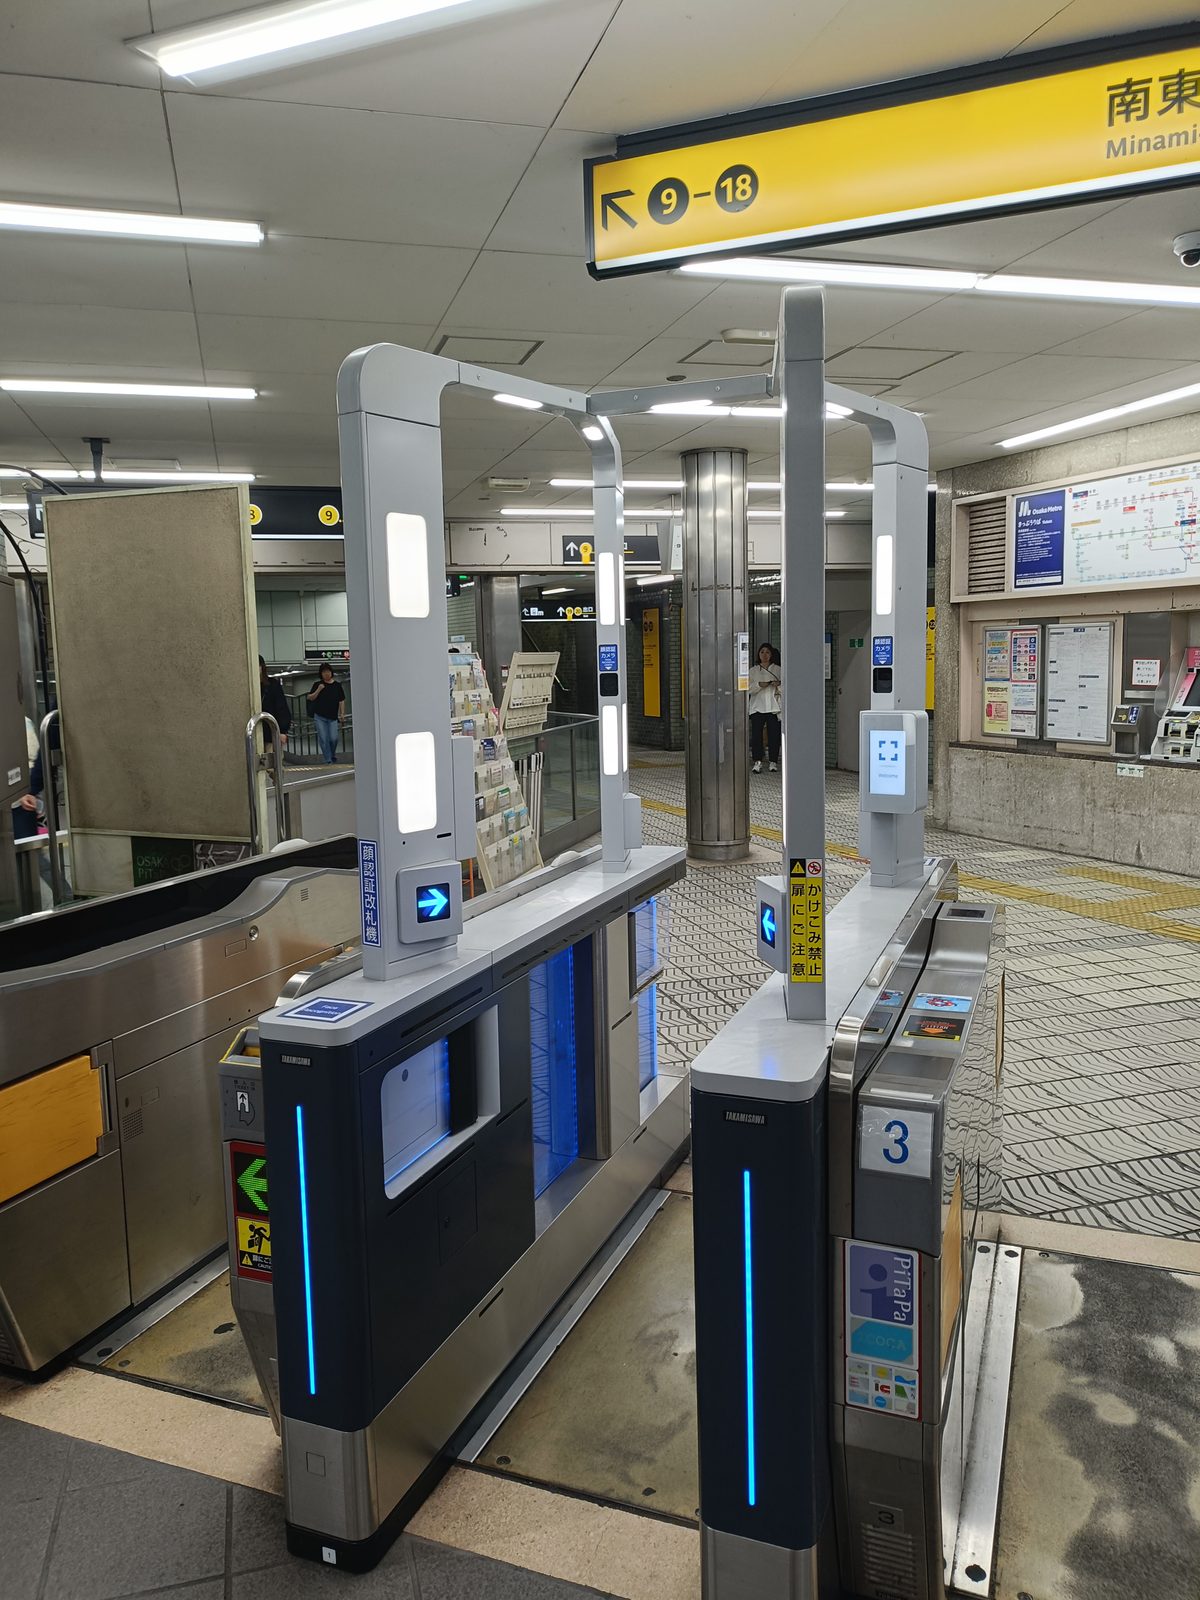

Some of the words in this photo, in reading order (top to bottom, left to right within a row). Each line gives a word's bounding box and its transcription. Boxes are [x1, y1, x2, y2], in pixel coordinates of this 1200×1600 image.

[1106, 124, 1200, 159] Minami
[325, 510, 333, 520] 9
[362, 845, 378, 943] 顔認証改札機
[791, 883, 806, 976] 扉にご注意
[808, 884, 822, 976] かけこみ禁止
[726, 1112, 765, 1124] TAKAMISAWA
[883, 1120, 909, 1164] 3
[893, 1256, 912, 1322] PiTaPa
[878, 1511, 894, 1524] 3
